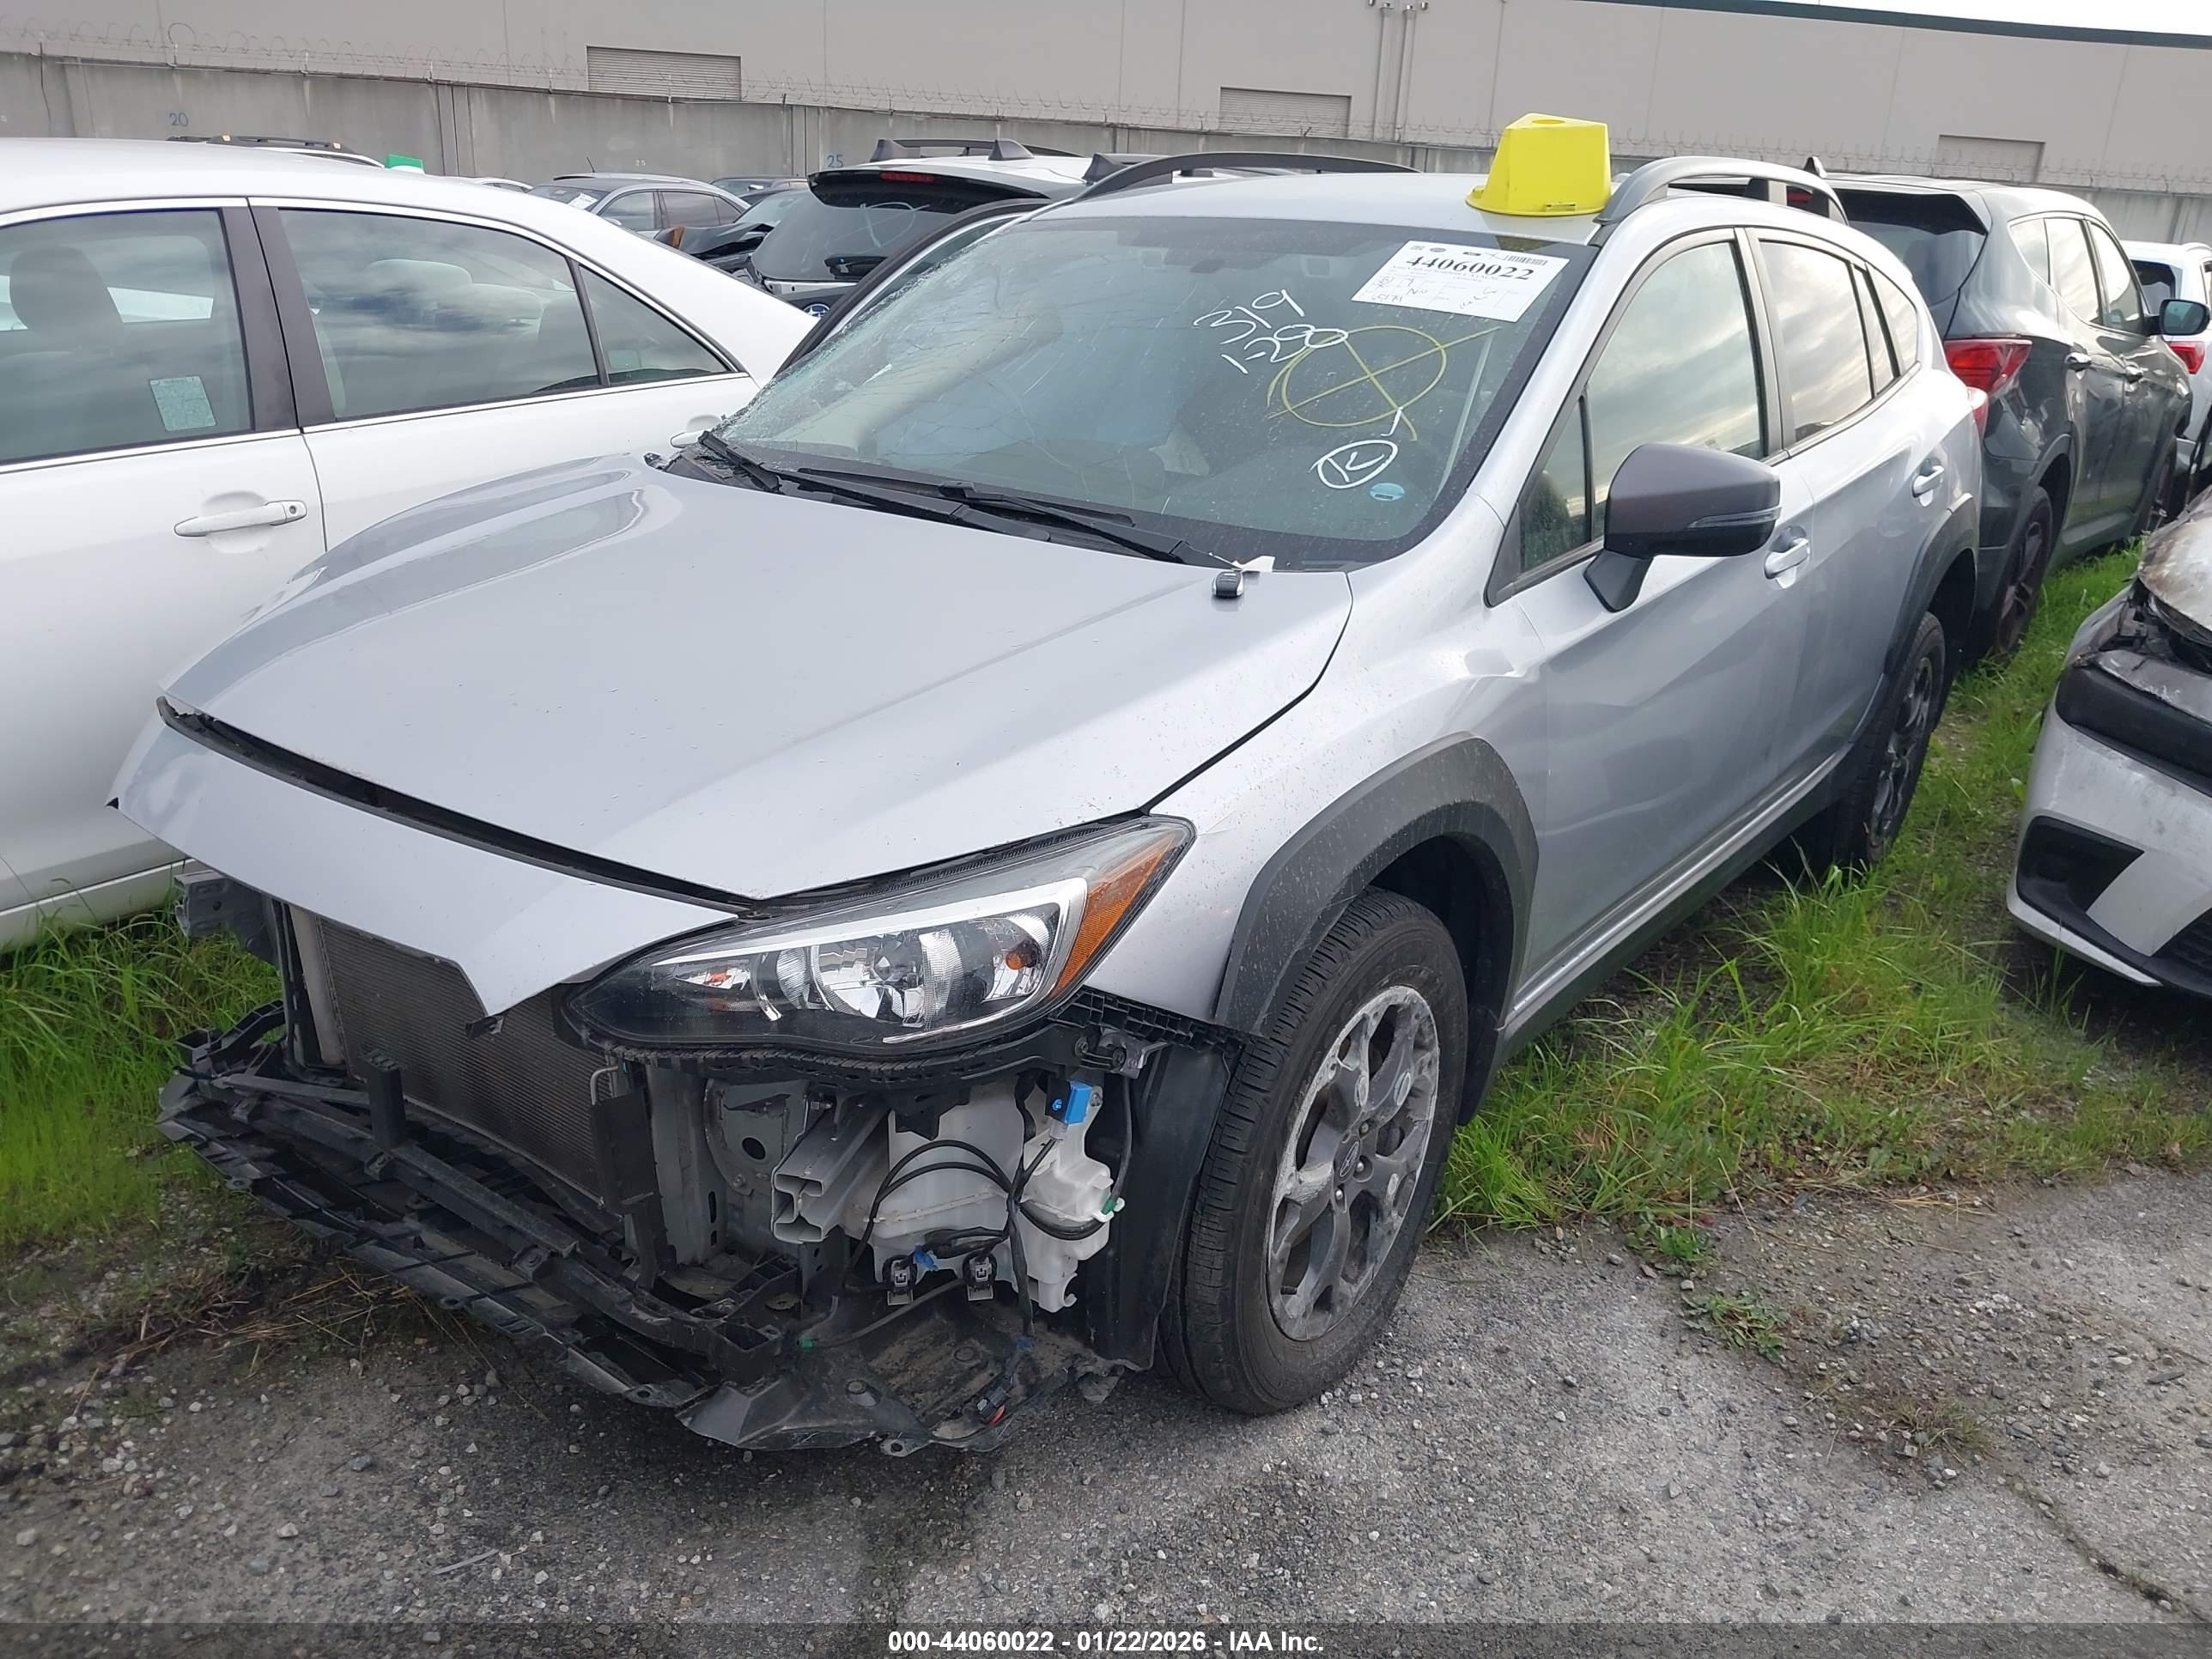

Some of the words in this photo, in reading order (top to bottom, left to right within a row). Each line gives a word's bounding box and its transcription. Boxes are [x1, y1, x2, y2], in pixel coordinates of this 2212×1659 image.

[168, 112, 189, 127] 20
[826, 154, 844, 168] 25
[1406, 255, 1534, 281] 44060022
[1193, 289, 1305, 345] 319
